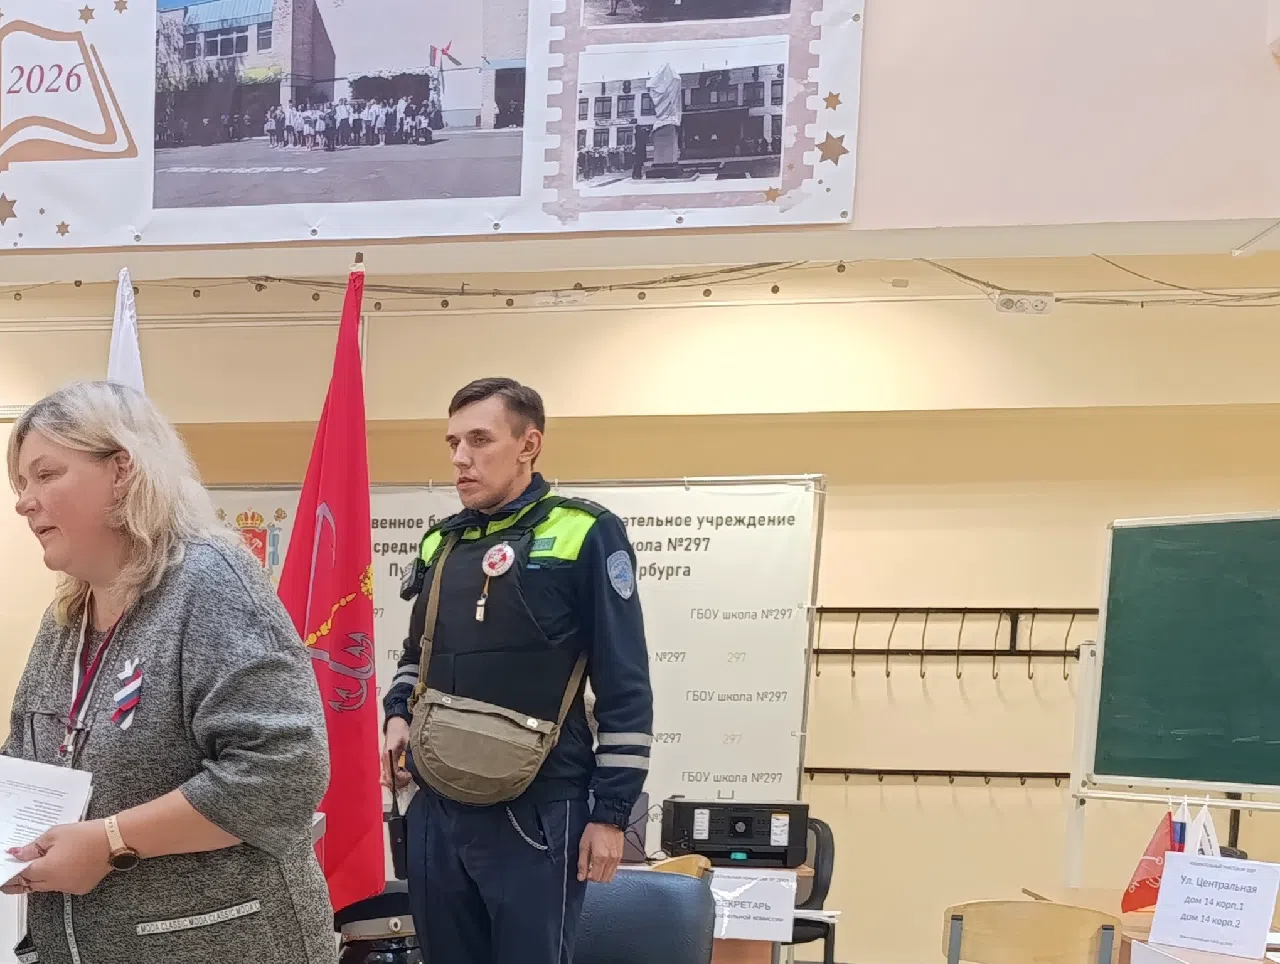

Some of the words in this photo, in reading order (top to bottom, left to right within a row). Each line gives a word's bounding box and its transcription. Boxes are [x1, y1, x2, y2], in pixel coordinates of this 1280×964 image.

[6, 62, 85, 94] 2026
[697, 514, 796, 531] учреждение
[667, 537, 710, 552] №297
[690, 608, 720, 620] ГБОУ
[722, 610, 758, 620] школа
[761, 608, 793, 620] №297
[654, 651, 686, 663] №297
[727, 652, 747, 663] 297
[685, 690, 716, 701] ГБОУ
[717, 692, 753, 702] школа
[756, 691, 788, 702] №297
[723, 733, 743, 744] 297
[681, 771, 710, 783] ГБОУ
[713, 773, 748, 783] школа
[751, 772, 783, 783] №297
[1180, 875, 1194, 885] Ул.
[1196, 877, 1258, 894] Центральная
[1184, 896, 1202, 904] дом
[1204, 897, 1214, 906] 14
[1215, 900, 1244, 911] корп.1
[1180, 913, 1199, 921] дом
[1200, 914, 1211, 923] 14
[1212, 917, 1241, 928] корп.2
